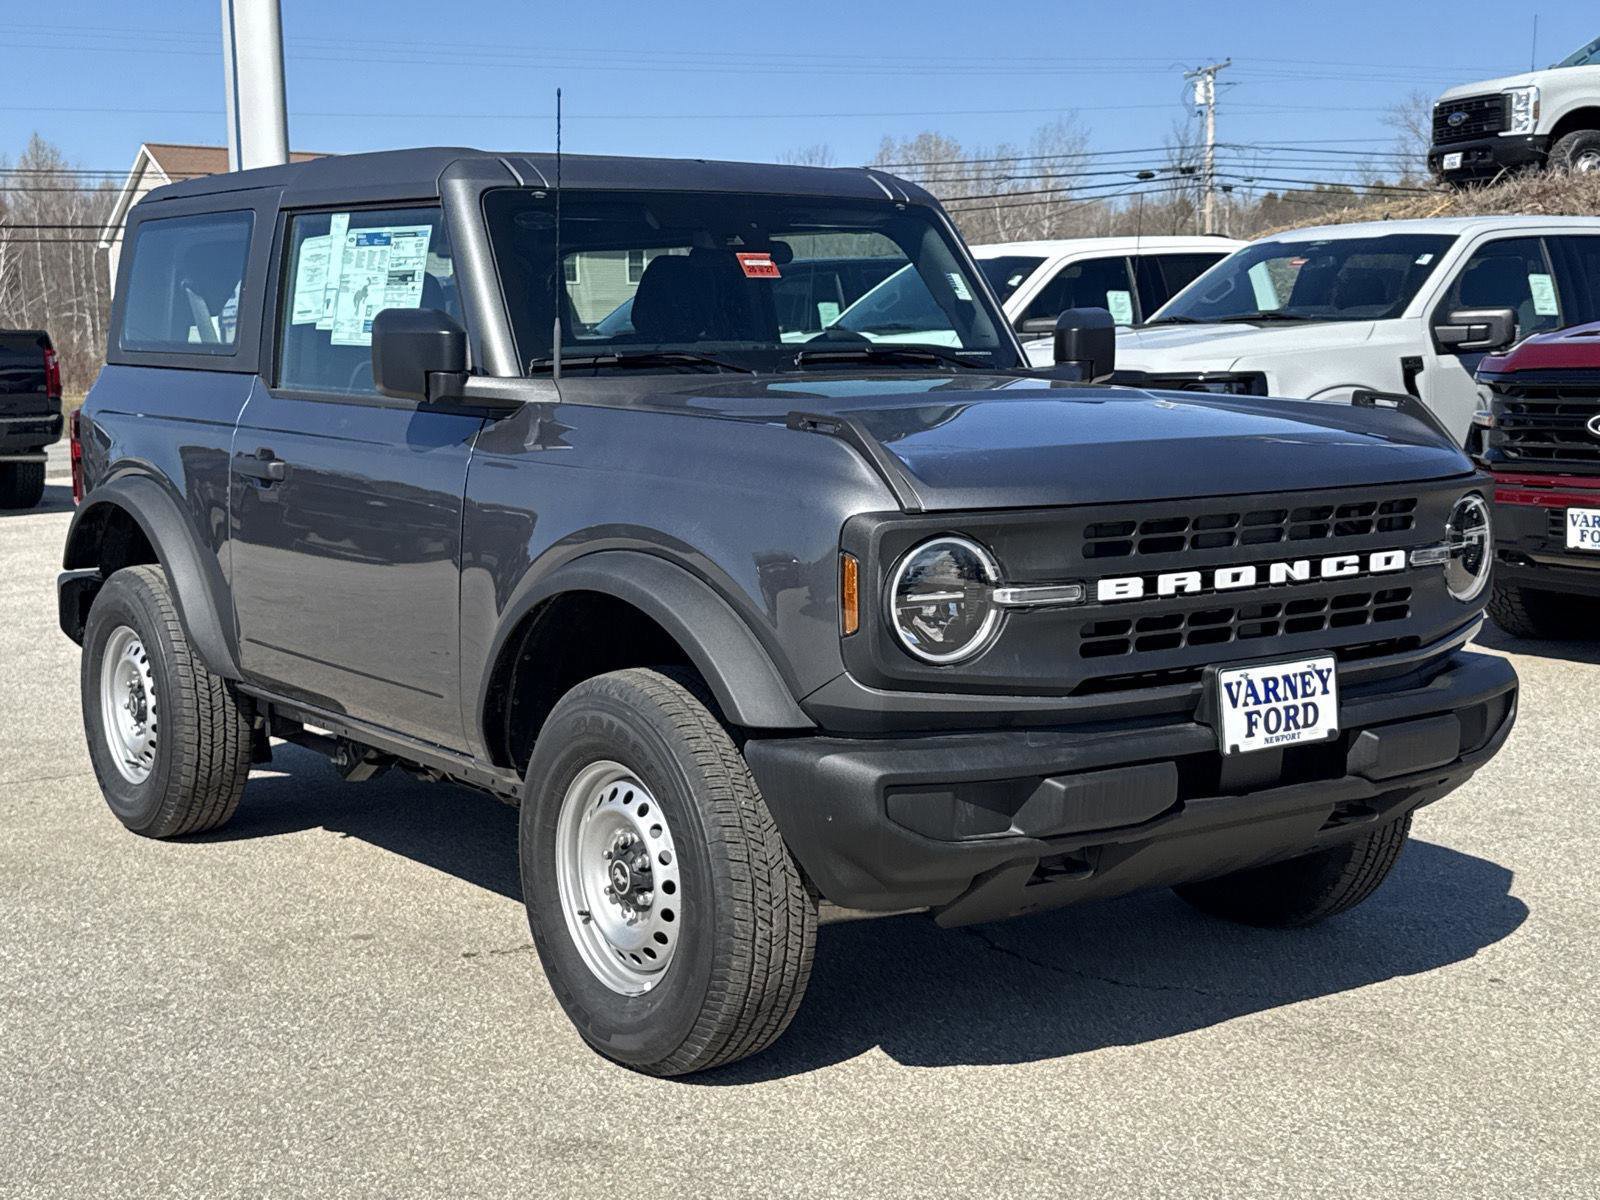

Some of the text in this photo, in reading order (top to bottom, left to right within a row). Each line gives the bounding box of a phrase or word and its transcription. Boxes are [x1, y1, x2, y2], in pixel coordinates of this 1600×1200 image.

[1097, 549, 1406, 602] BRONCO
[1223, 666, 1332, 709] VARNEY
[1244, 702, 1320, 739] FORD
[1263, 731, 1302, 745] NEWPORT
